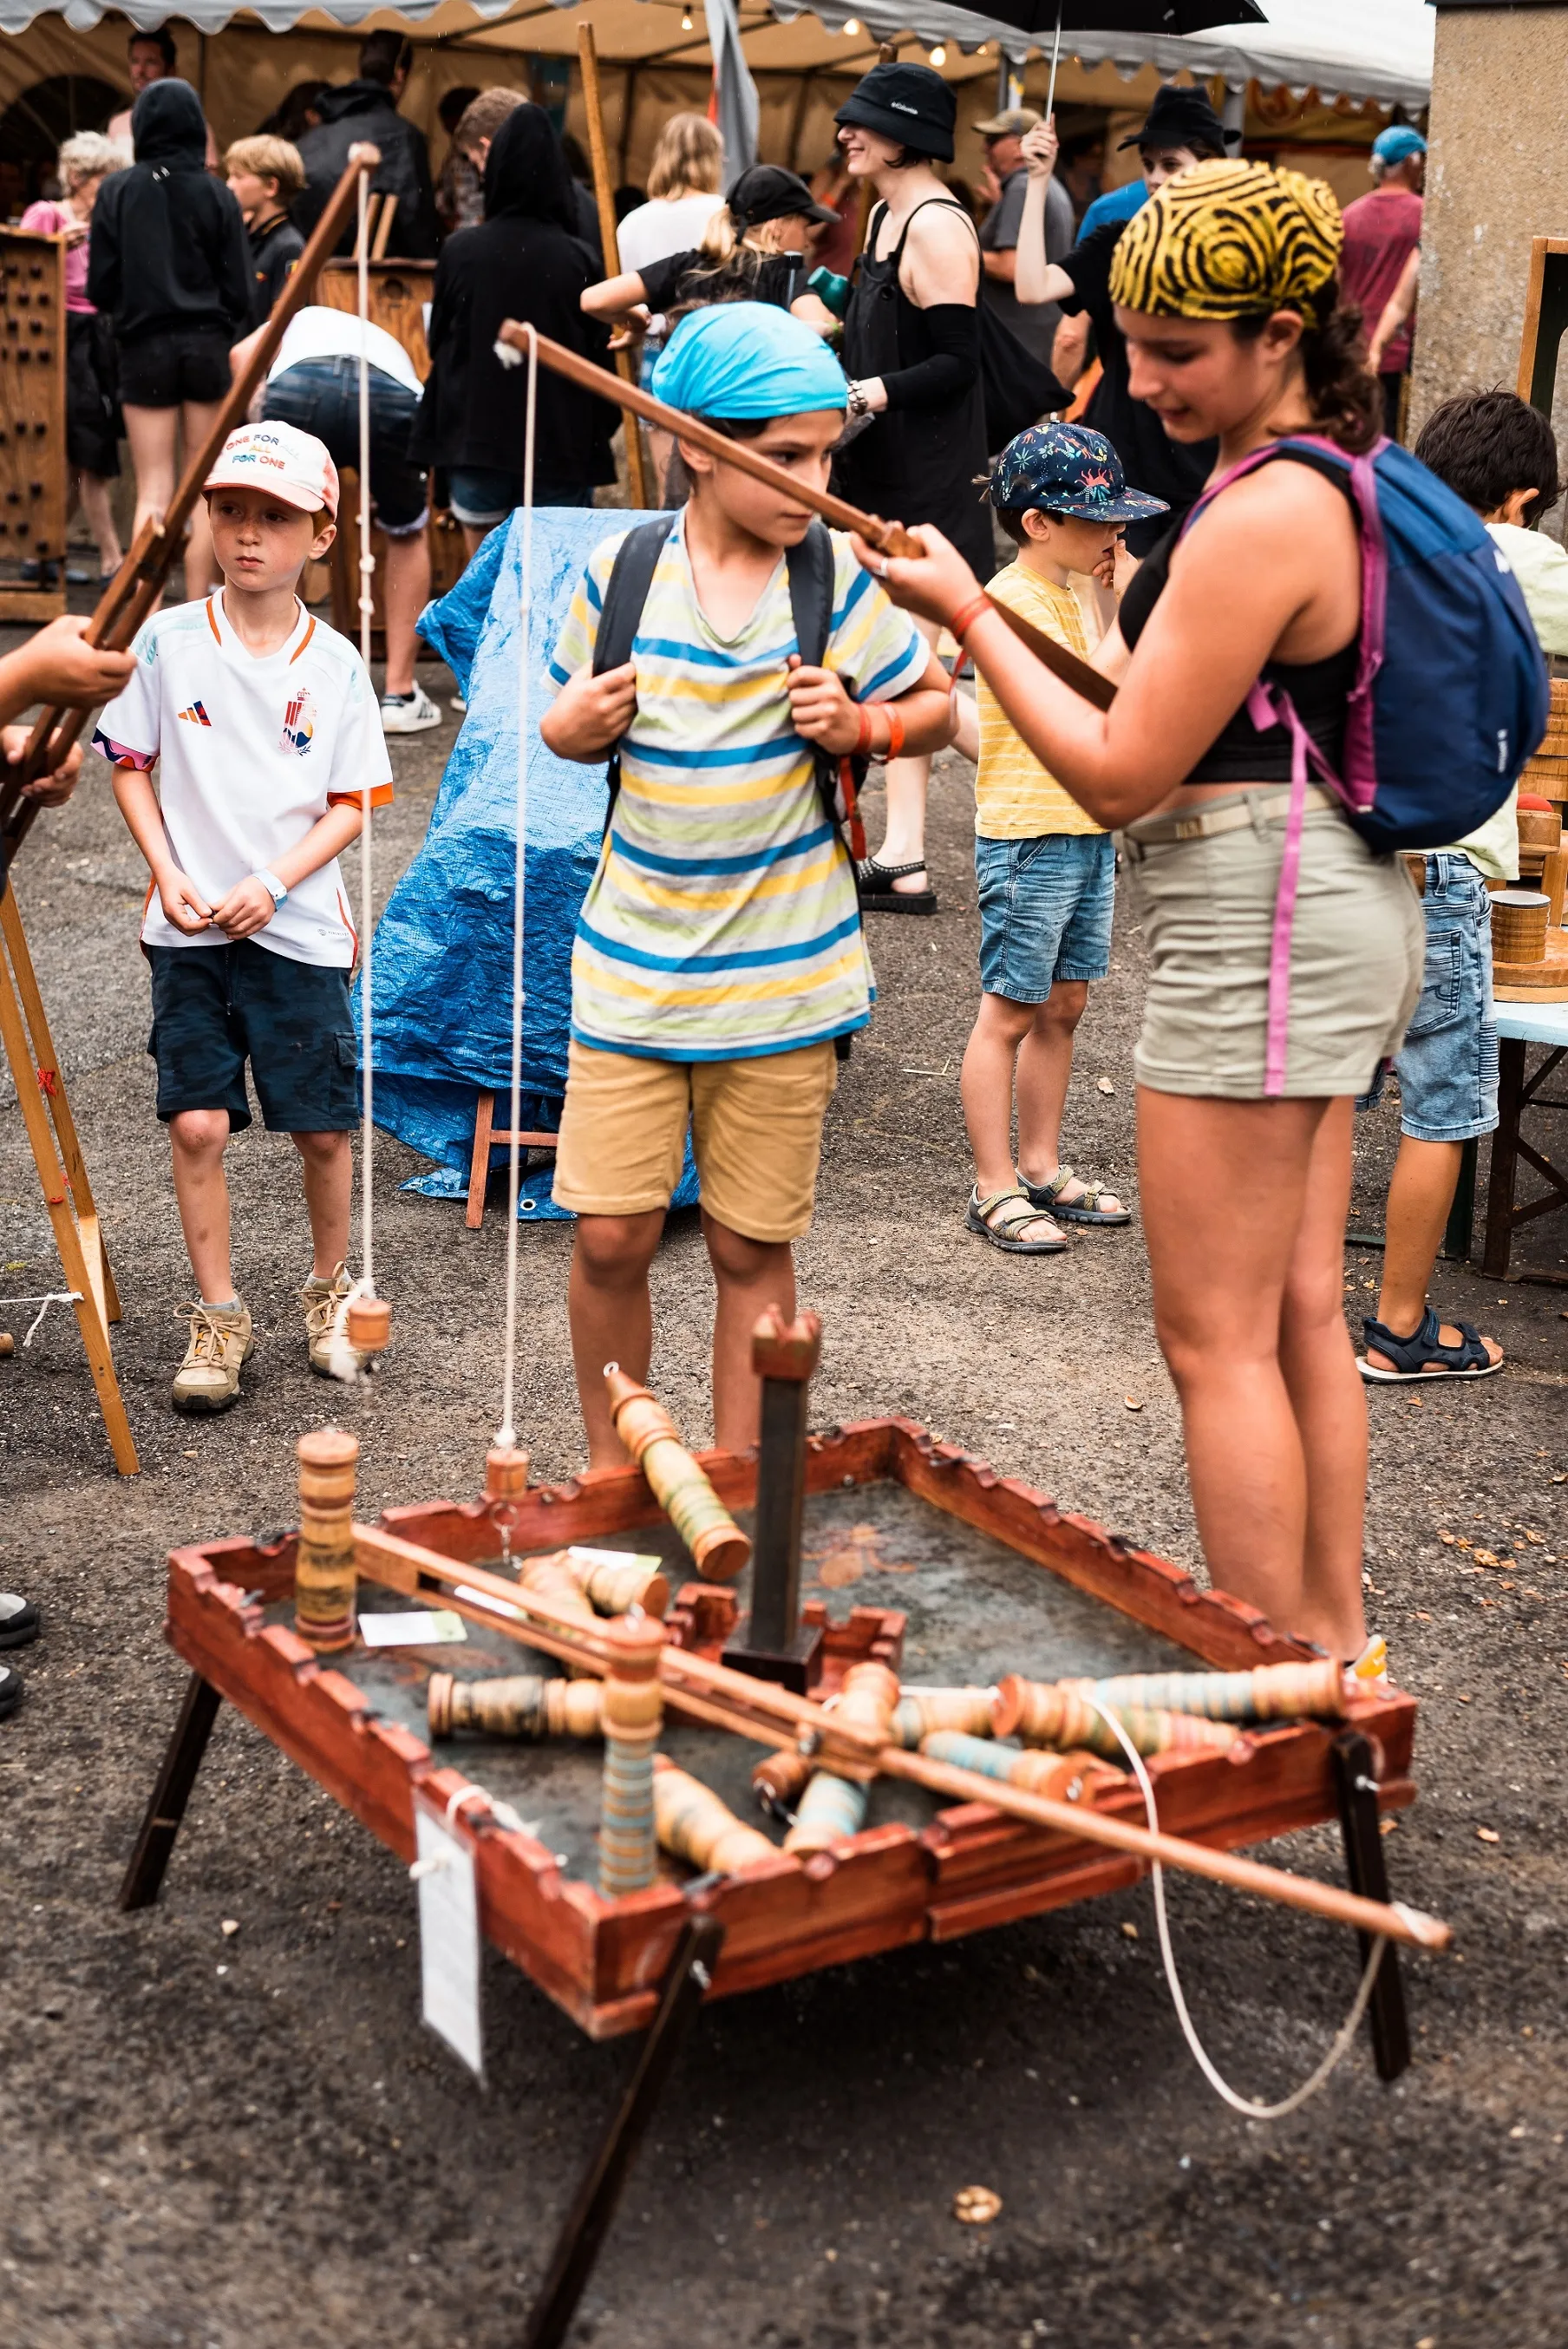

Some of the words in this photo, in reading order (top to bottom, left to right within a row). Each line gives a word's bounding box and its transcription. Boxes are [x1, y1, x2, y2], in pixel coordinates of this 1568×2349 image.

[226, 435, 250, 450] ONE
[254, 435, 279, 446] FOR
[249, 443, 271, 454] ALL
[232, 454, 257, 464] FOR
[259, 455, 285, 469] ONE
